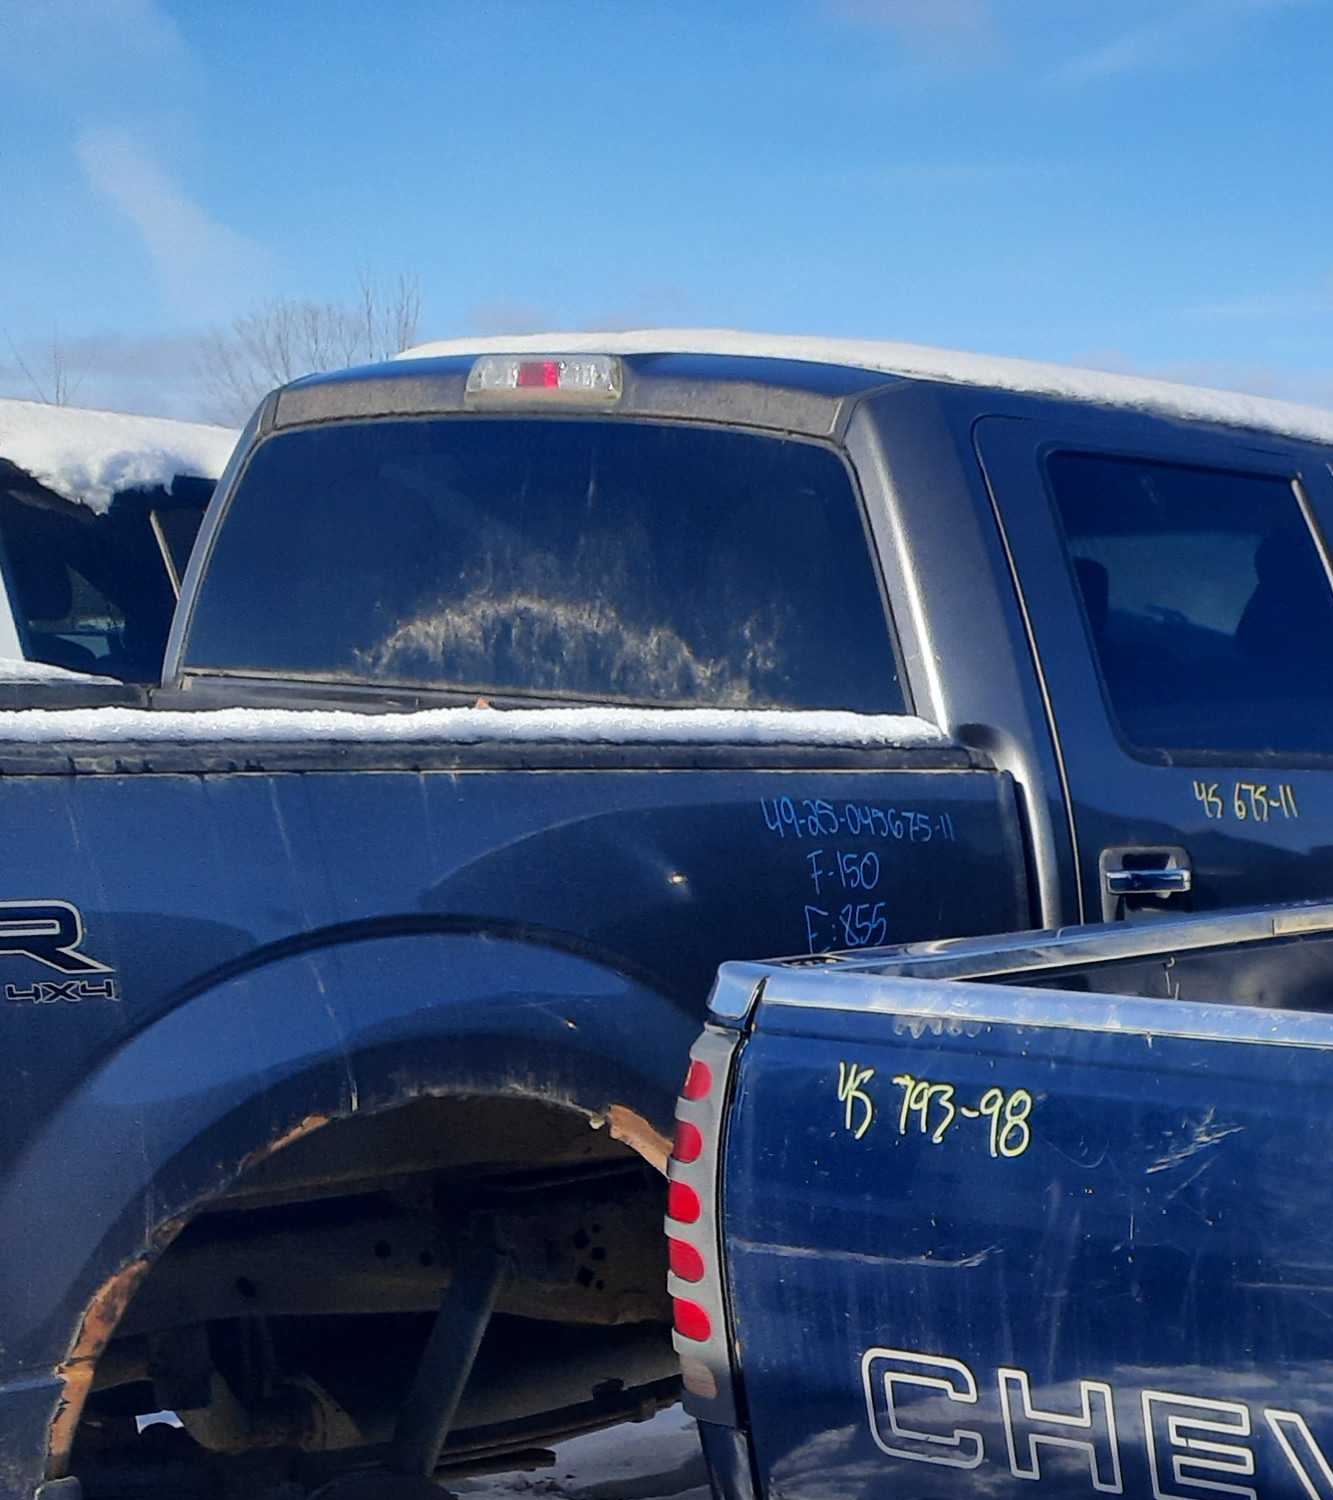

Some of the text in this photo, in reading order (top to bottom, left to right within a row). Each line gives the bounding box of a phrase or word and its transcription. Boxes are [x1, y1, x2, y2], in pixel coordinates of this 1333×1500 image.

[1192, 780, 1300, 821] 45 675-11
[806, 849, 880, 895] F-150
[892, 1073, 1033, 1159] 793-98
